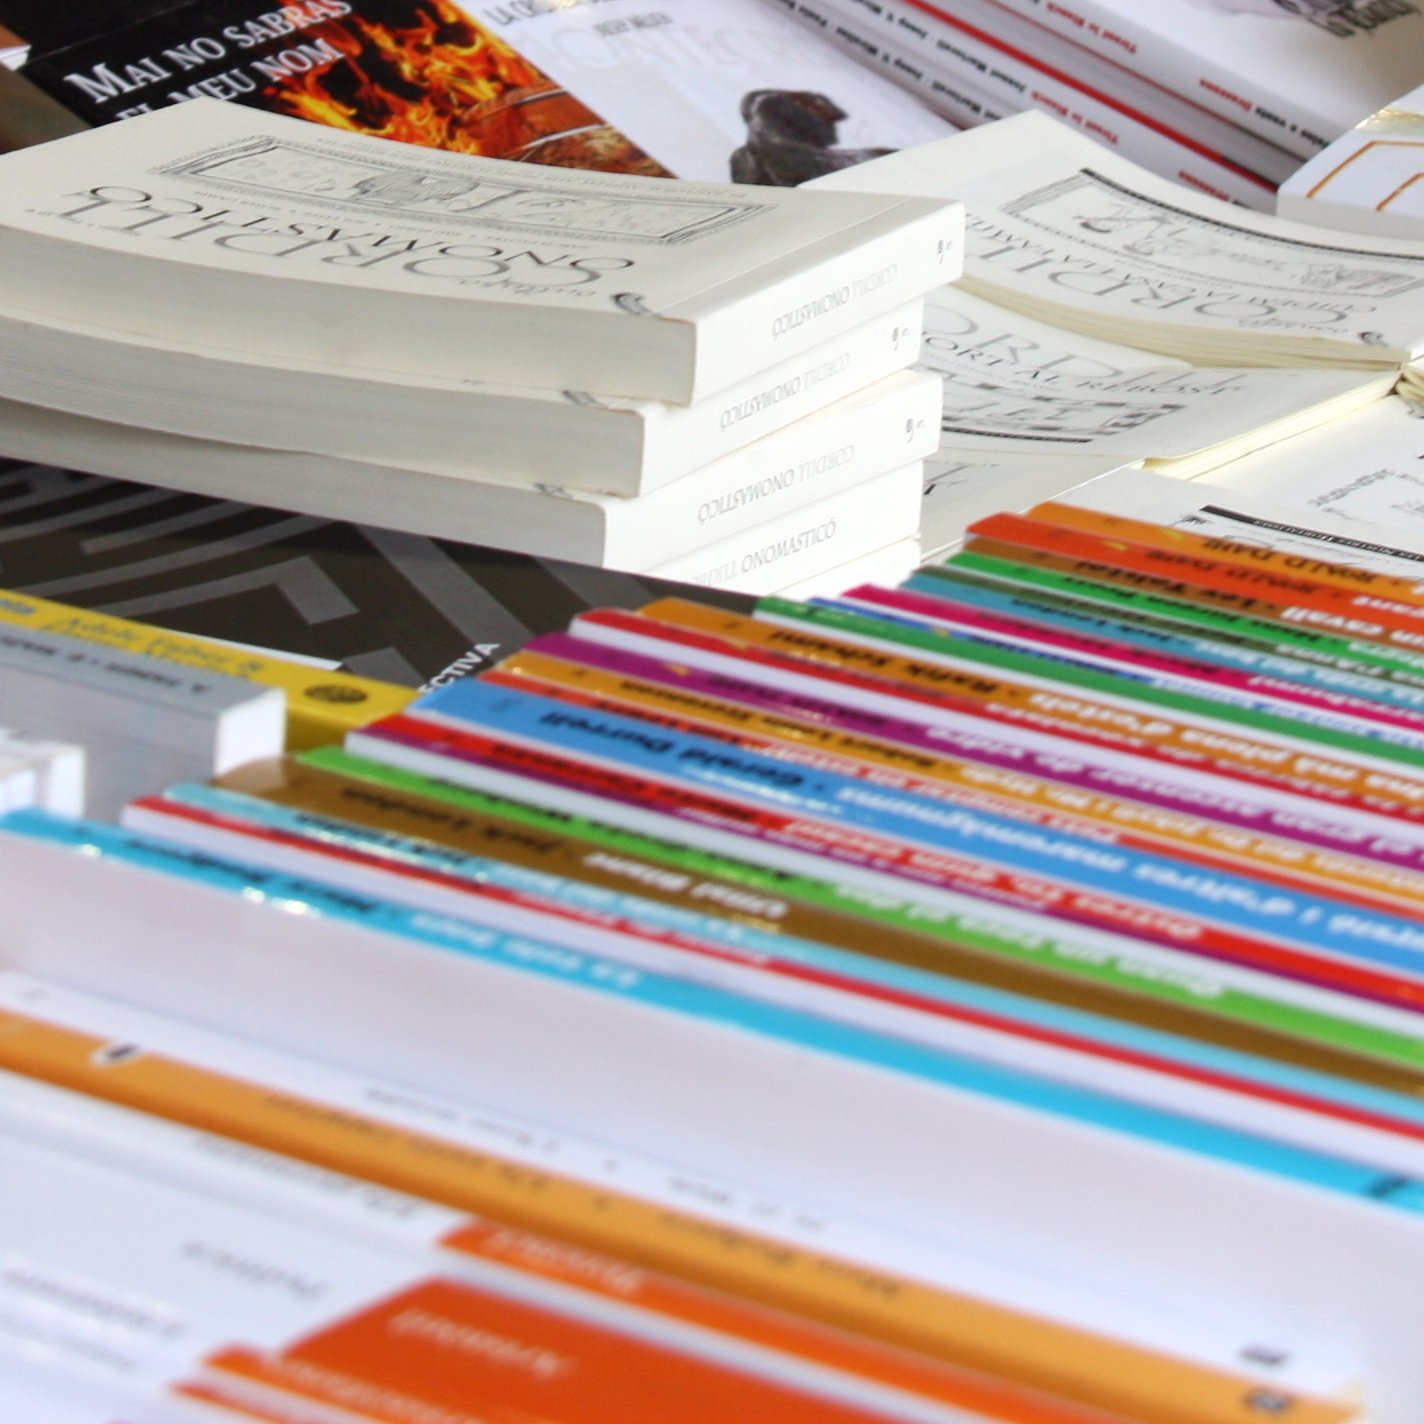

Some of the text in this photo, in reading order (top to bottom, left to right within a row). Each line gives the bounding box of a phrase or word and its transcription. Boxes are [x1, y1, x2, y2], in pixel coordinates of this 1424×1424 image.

[64, 57, 172, 105] MAI
[175, 38, 226, 72] NO
[177, 39, 344, 103] MEU NOM
[740, 517, 837, 575] ONOMASTICÓ
[1281, 607, 1383, 636] cavall
[539, 711, 672, 756] Durrell
[1181, 725, 1294, 764] plena
[680, 748, 803, 790] Gerald
[1293, 756, 1359, 785] mà
